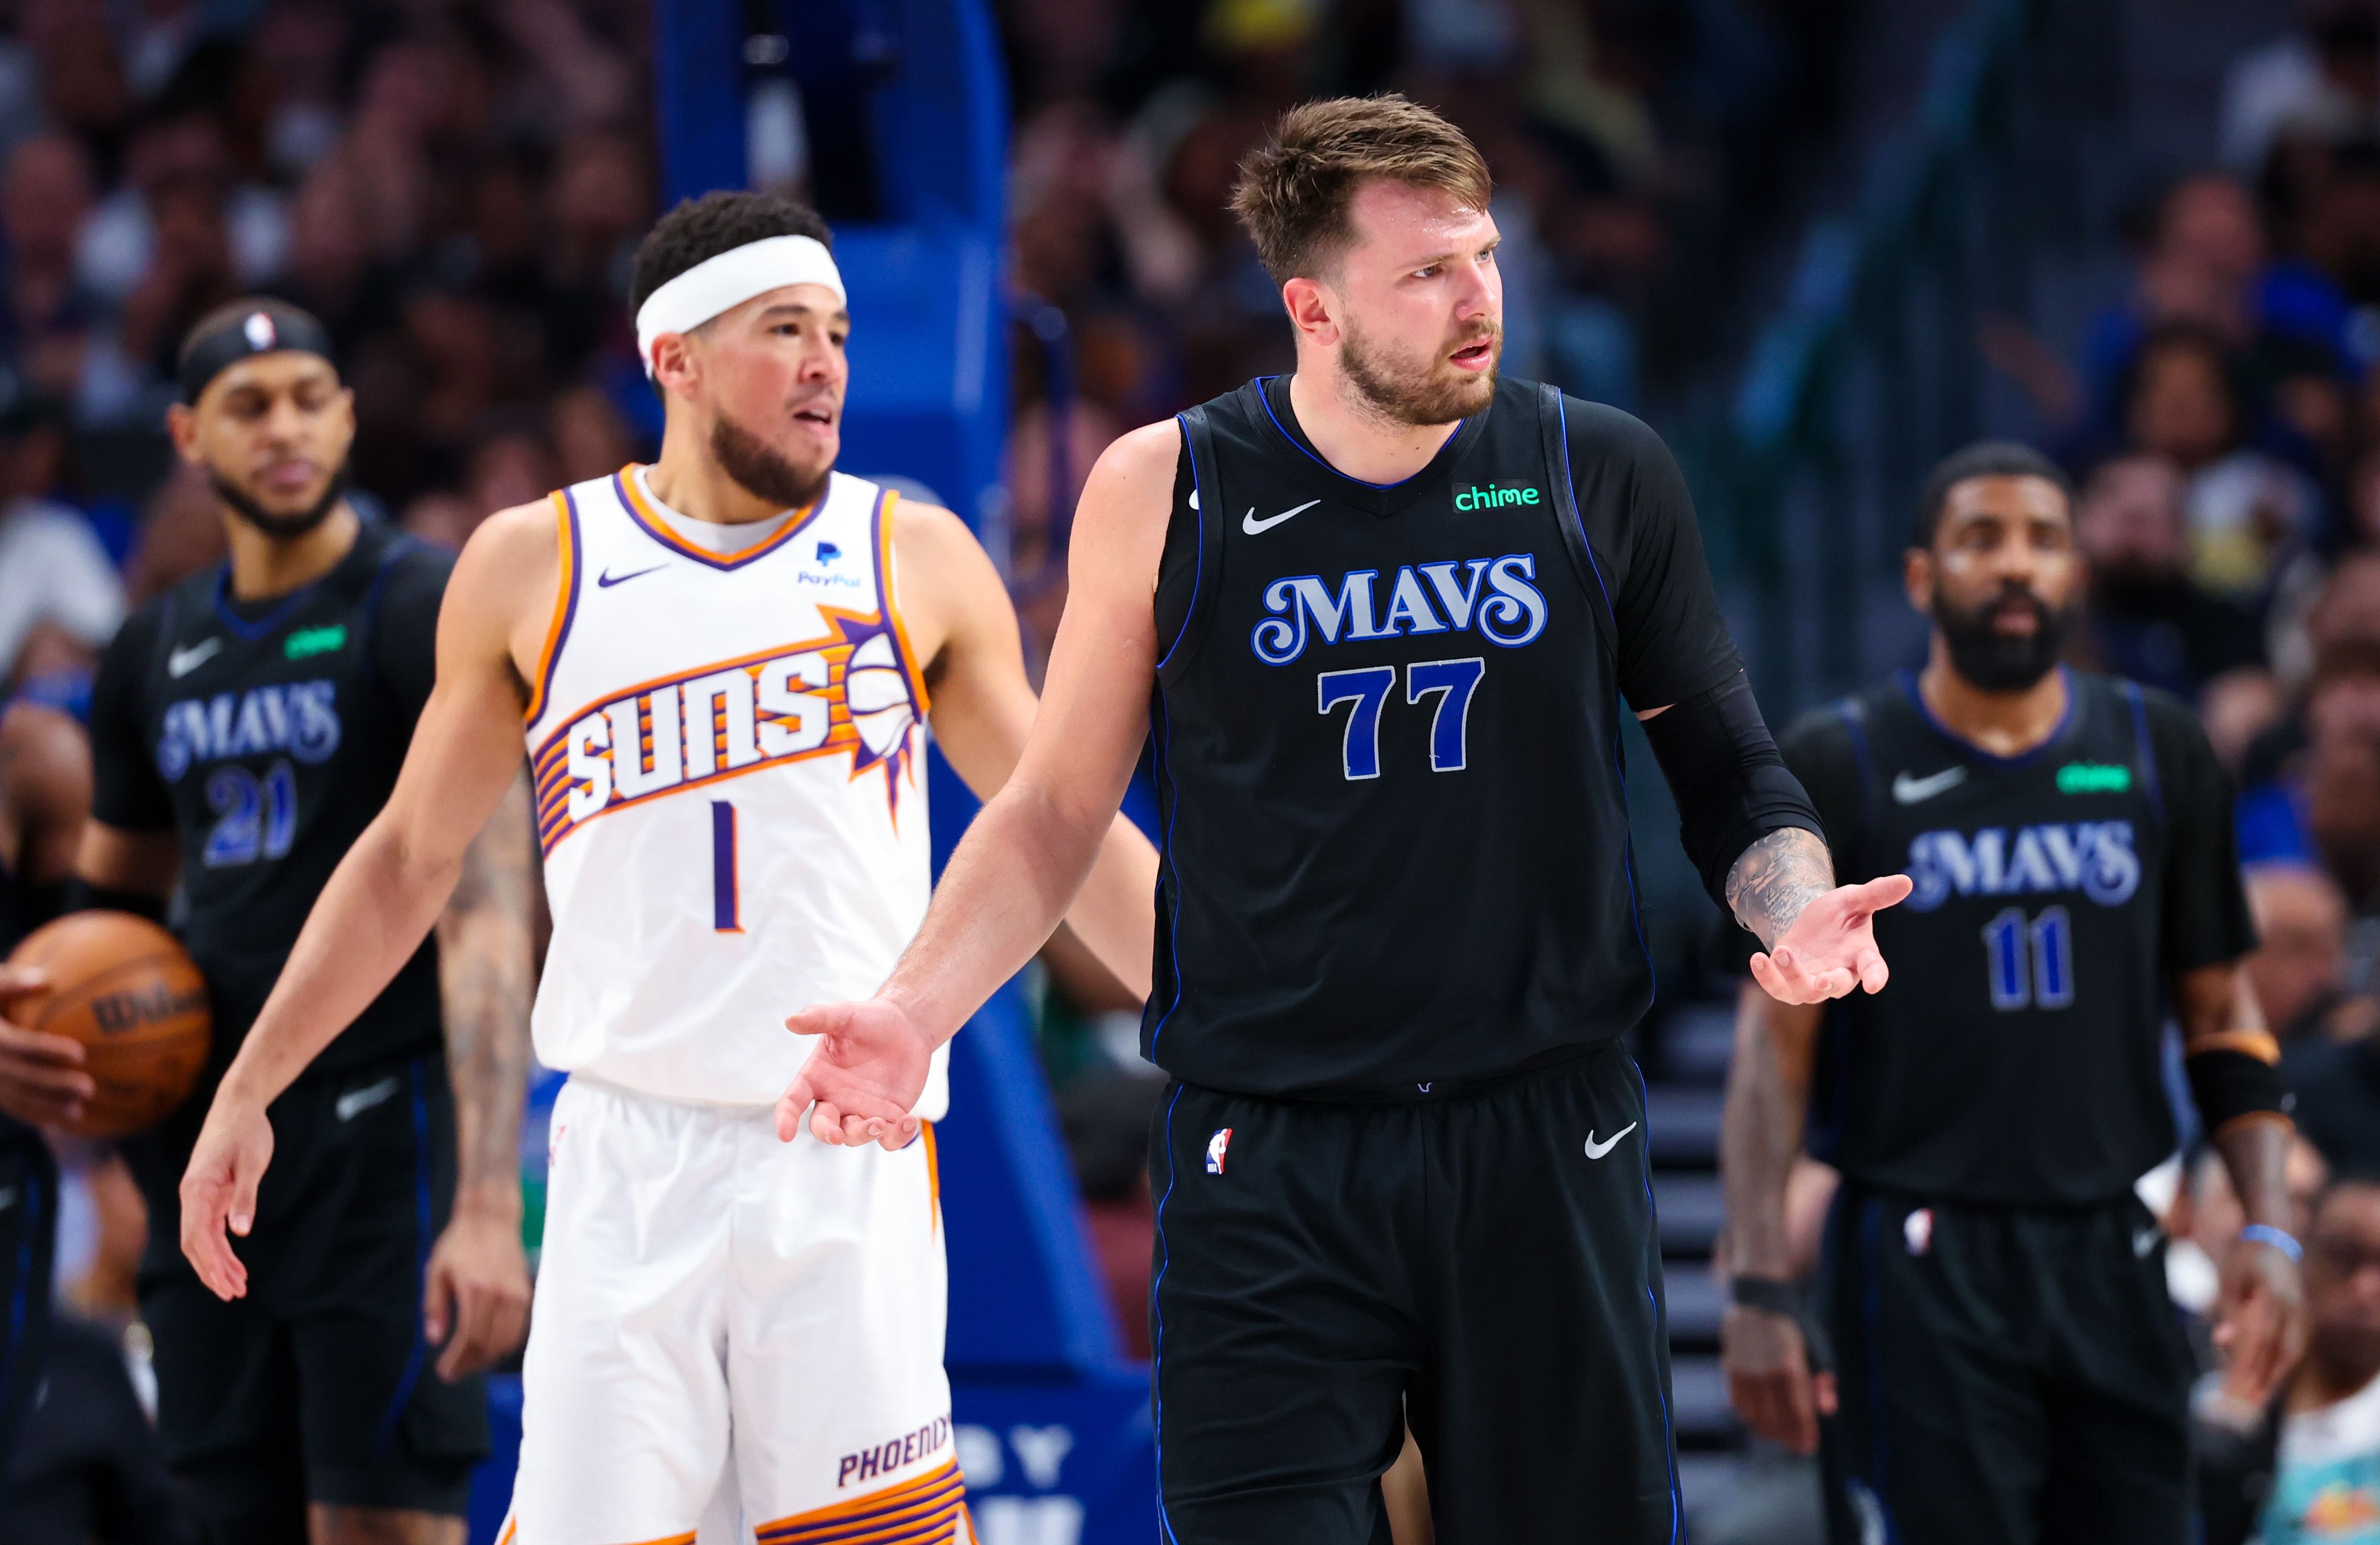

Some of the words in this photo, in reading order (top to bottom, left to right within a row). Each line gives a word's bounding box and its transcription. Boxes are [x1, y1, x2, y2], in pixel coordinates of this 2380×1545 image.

[1455, 484, 1540, 512] chime
[798, 571, 861, 587] PayPal
[1251, 553, 1548, 666] MAVS
[160, 680, 341, 780] MAVS
[1317, 657, 1485, 781] 77
[204, 762, 296, 868] 21
[711, 800, 745, 933] 1
[1901, 820, 2142, 912] MAVS
[1981, 906, 2074, 1012] 11
[1208, 1163, 1218, 1173] NBA
